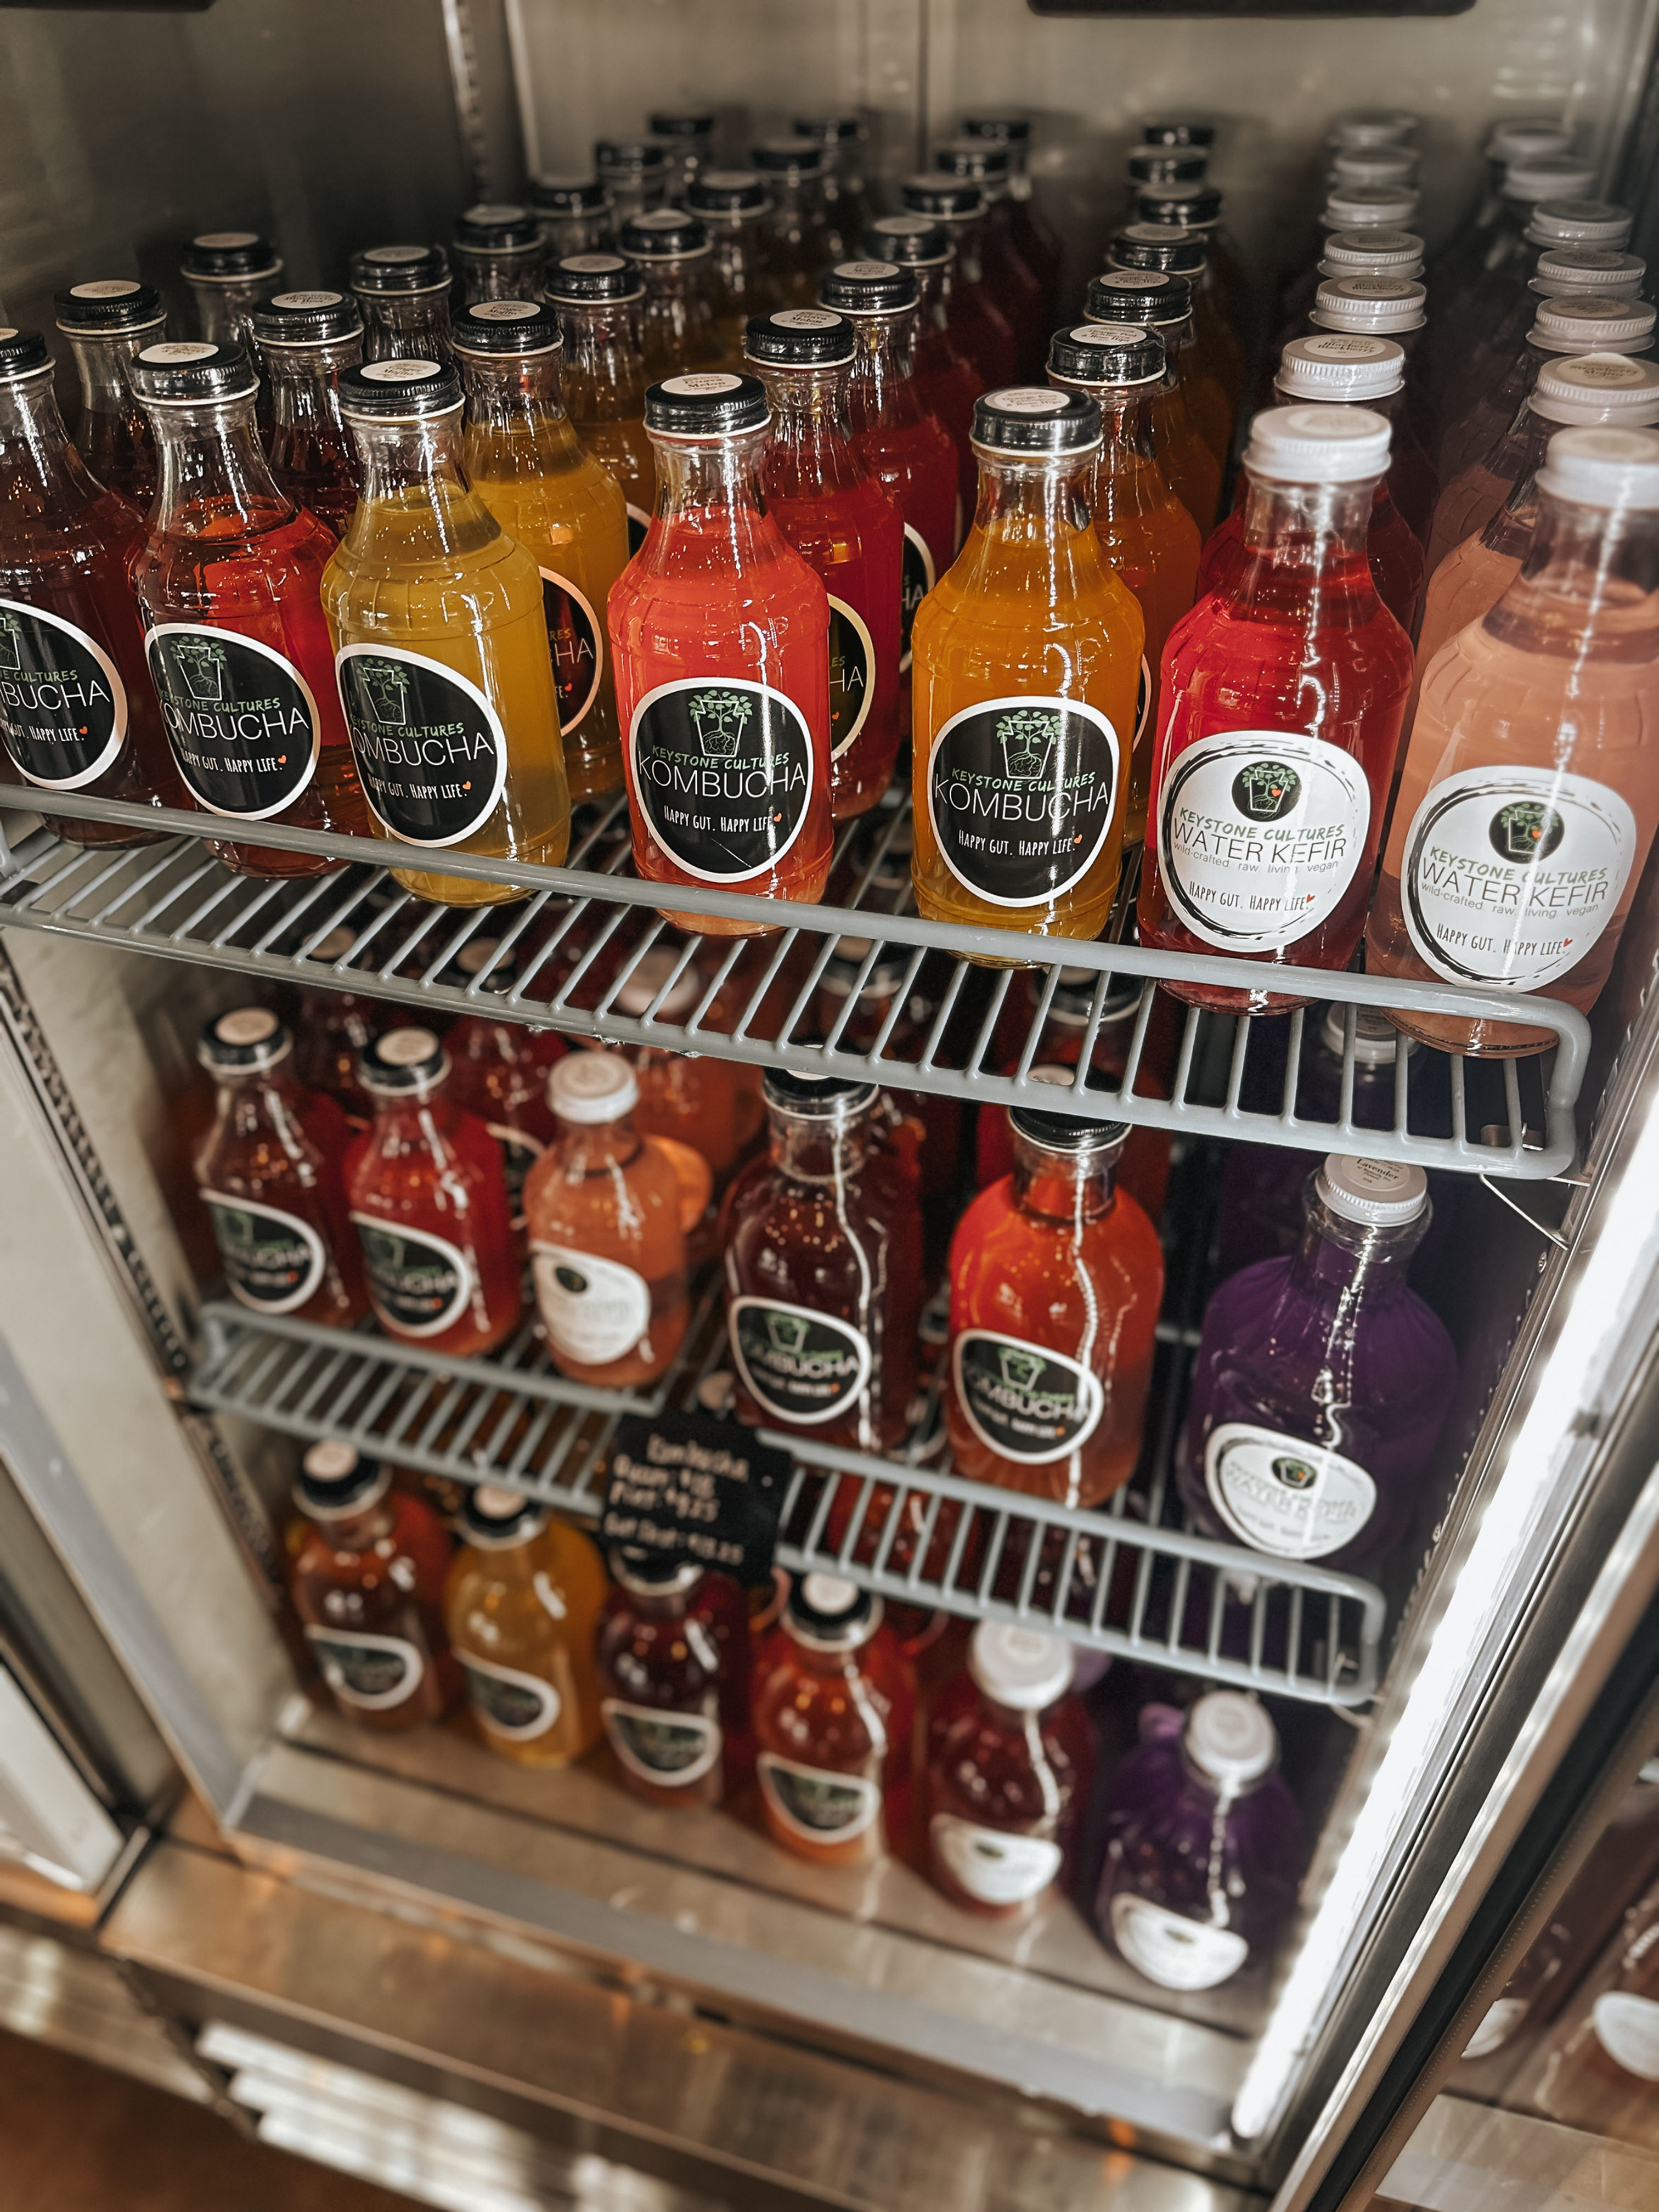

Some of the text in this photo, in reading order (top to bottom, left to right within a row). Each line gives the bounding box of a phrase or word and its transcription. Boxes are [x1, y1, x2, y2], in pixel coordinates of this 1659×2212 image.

[14, 670, 78, 684] CULTURES
[0, 680, 110, 710] BUCHA
[161, 690, 281, 713] ESTONE CULTURES
[29, 725, 57, 742] HAPPY
[58, 728, 84, 742] LIFE.
[397, 722, 465, 738] CULTURES
[224, 757, 254, 773] HAPPY
[256, 757, 283, 772] LIFE.
[652, 744, 790, 771] KEYSTONE CULTURES
[637, 750, 806, 799] KOMBUCHA
[951, 768, 1096, 792] KEYSTONE CULURES
[409, 783, 438, 800] HAPPY
[441, 783, 468, 799] LIFE.
[934, 773, 1109, 822] KOMBUCHA
[663, 805, 690, 827] HAPPY
[720, 816, 750, 833] HAPPY
[1180, 807, 1345, 842] KEYSTONE CULTURES
[958, 829, 986, 851] HAPPY
[1018, 840, 1049, 856] HAPPY
[1052, 838, 1076, 855] LIFE.
[1174, 817, 1347, 864] WATER KEFIR
[1307, 860, 1339, 873] vegan
[1430, 845, 1516, 881] KEYSTONE
[1423, 857, 1609, 907] WATER KEFIR
[1189, 881, 1217, 903] HAPPY
[1250, 895, 1282, 911] HAPPY
[1566, 904, 1599, 917] vegan
[1436, 923, 1468, 947] HAPPY
[1356, 1158, 1399, 1180] Lavender
